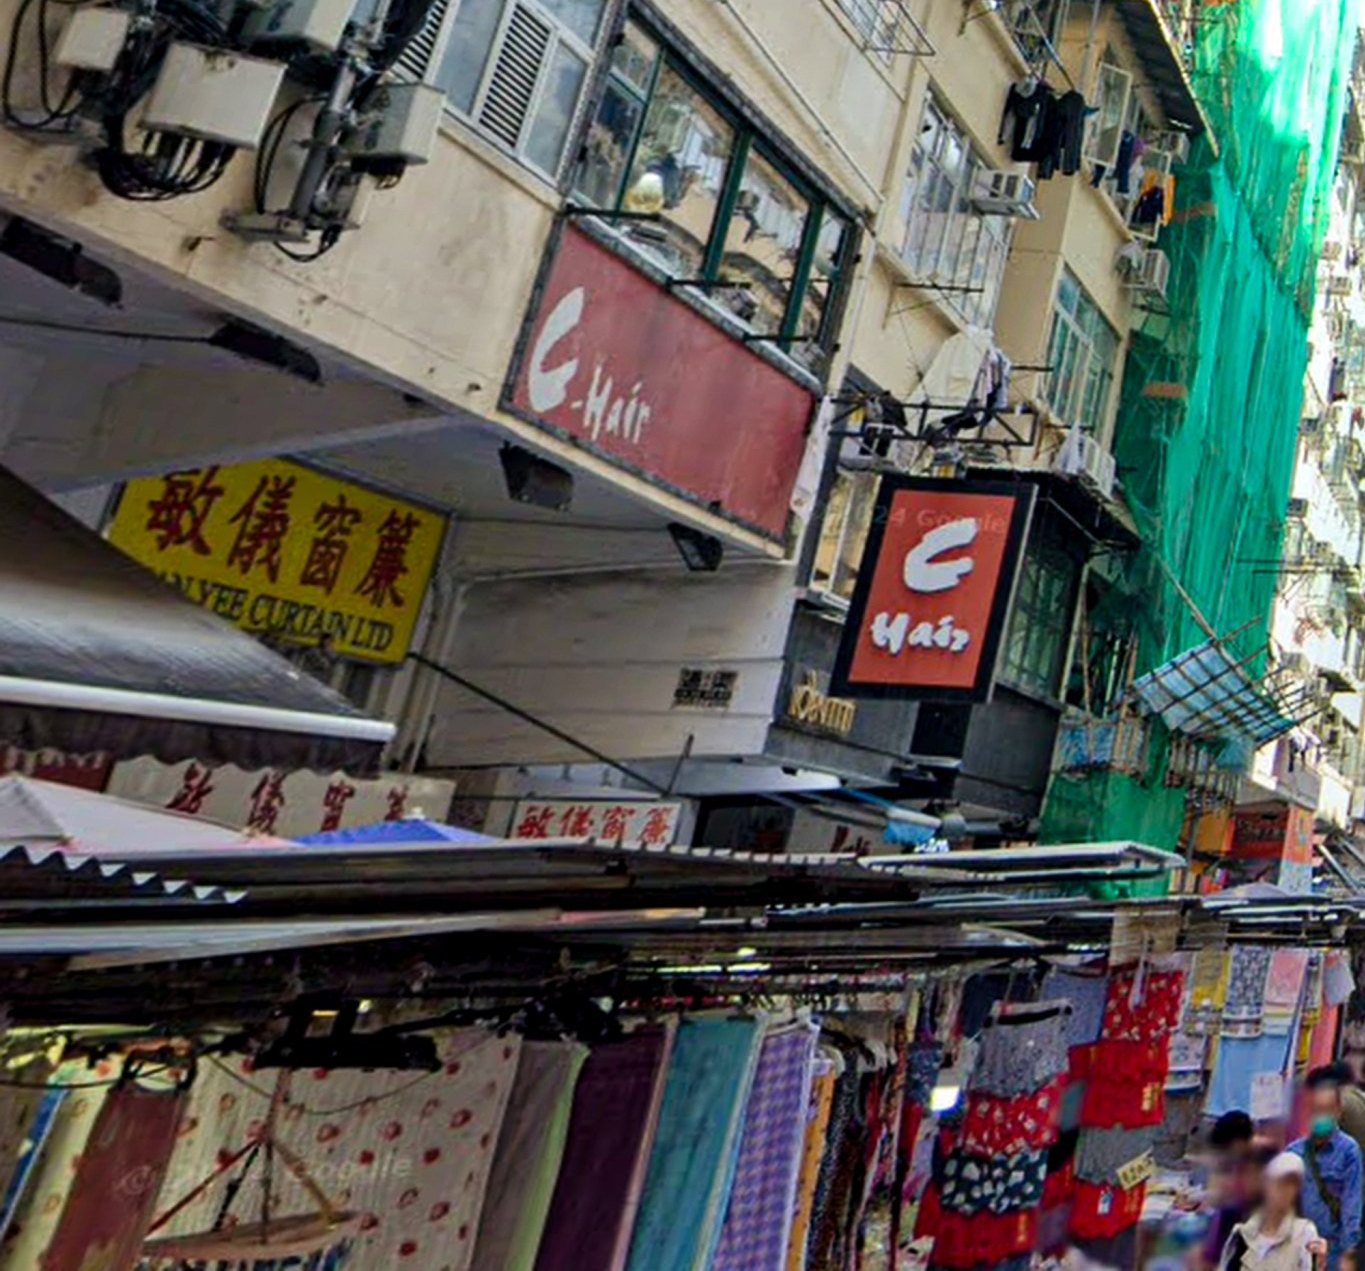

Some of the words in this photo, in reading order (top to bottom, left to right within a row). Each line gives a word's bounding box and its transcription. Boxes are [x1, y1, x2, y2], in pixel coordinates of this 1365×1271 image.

[250, 592, 348, 639] CURTAIN
[350, 615, 394, 653] LTD
[870, 612, 970, 657] Hair
